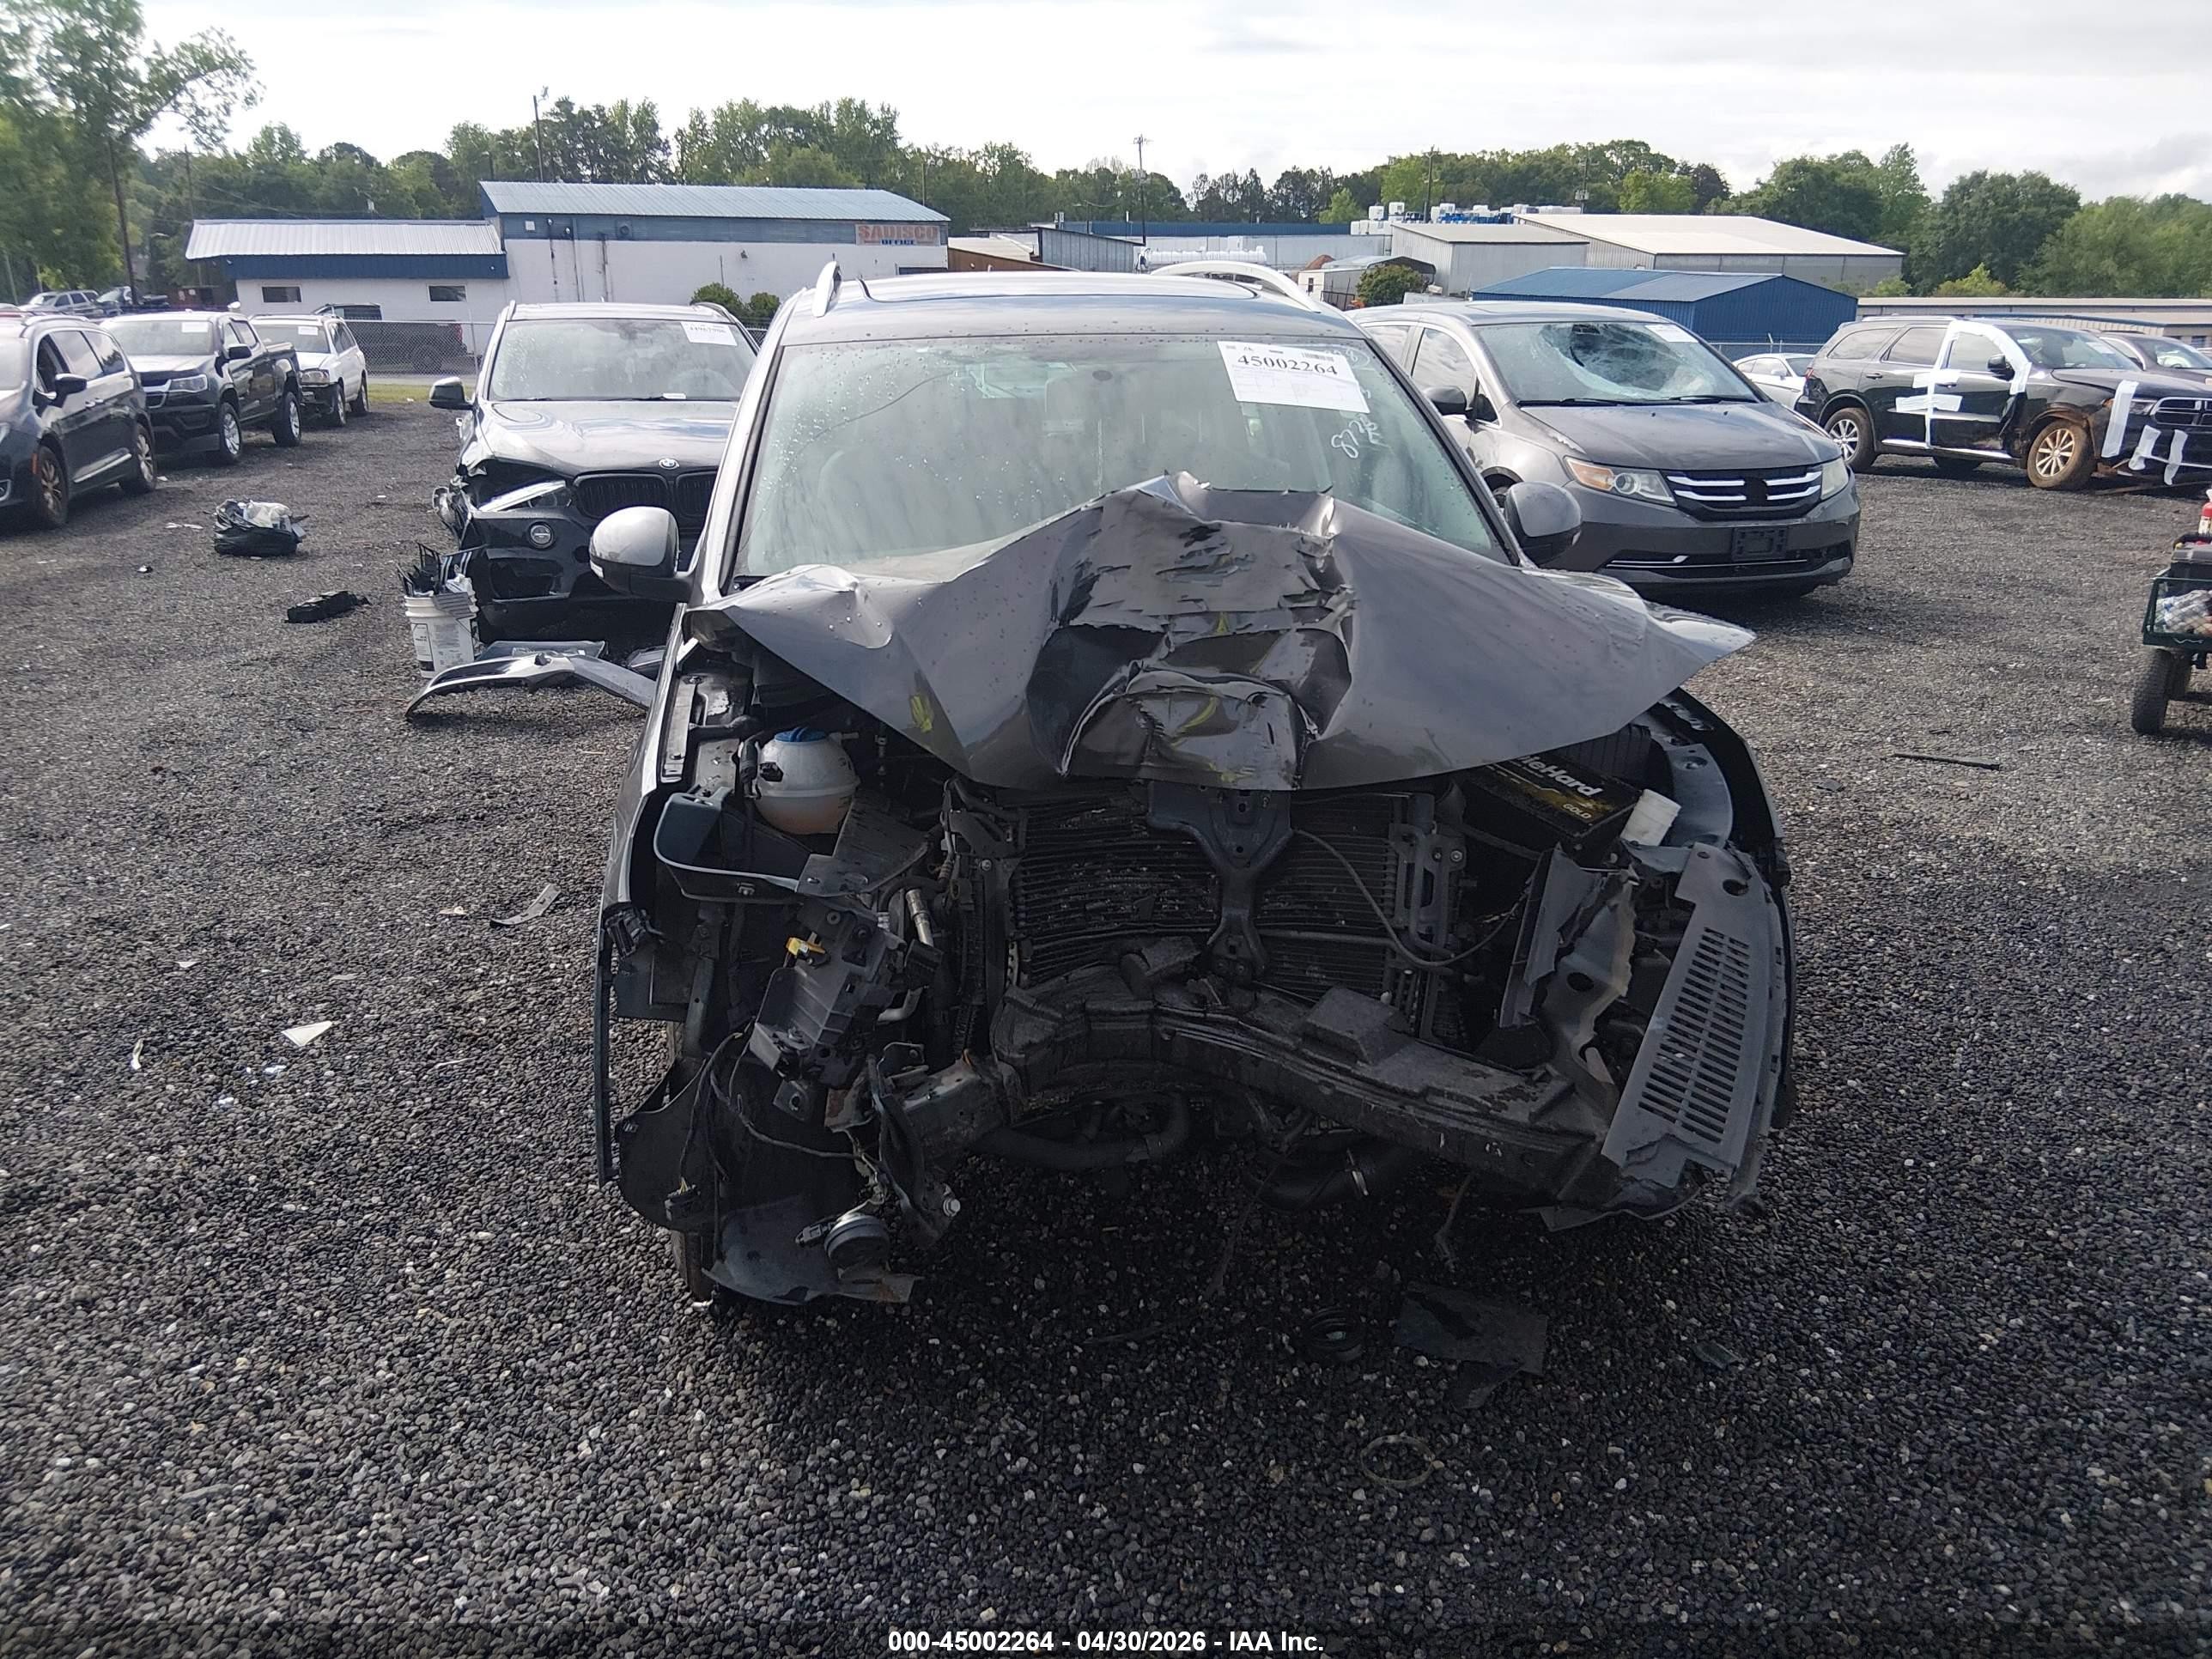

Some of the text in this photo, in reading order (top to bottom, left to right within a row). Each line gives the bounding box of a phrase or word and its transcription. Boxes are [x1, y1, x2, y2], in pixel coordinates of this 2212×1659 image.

[860, 226, 938, 240] SADISCO
[1237, 355, 1338, 375] 45002264
[1518, 755, 1603, 797] ieHard
[1563, 803, 1592, 819] GOLD
